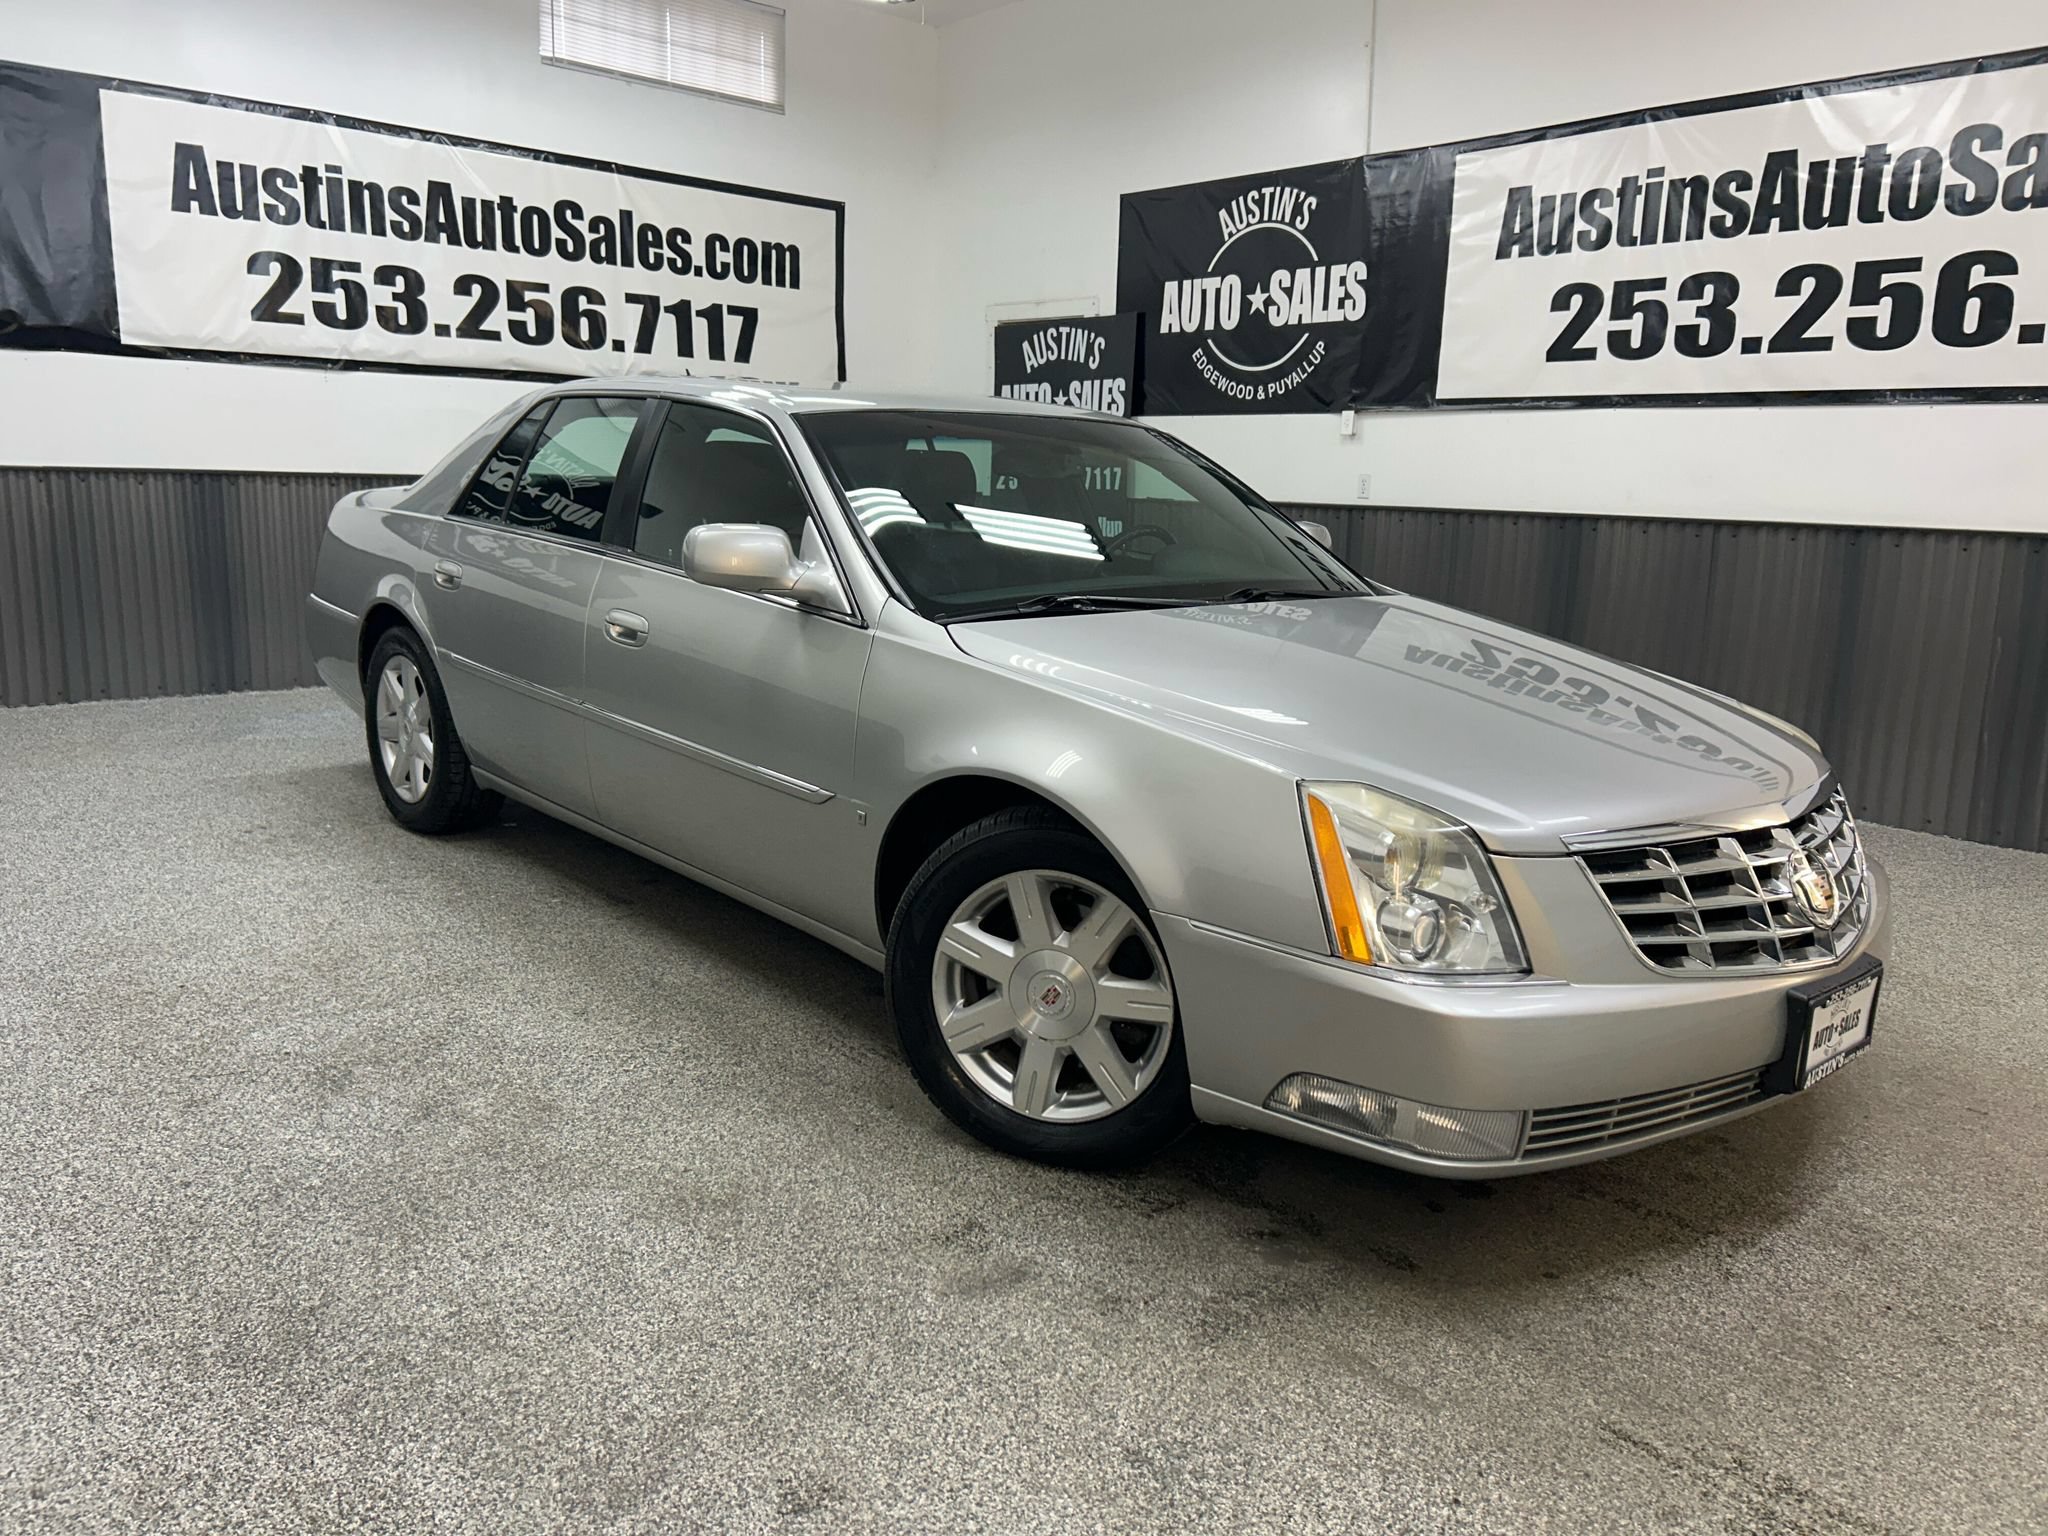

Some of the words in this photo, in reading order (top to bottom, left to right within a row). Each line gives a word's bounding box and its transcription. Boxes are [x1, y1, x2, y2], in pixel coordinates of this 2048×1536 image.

[171, 141, 801, 291] AustinsAutoSales.com
[1218, 186, 1318, 241] AUSTIN'S
[1495, 123, 2048, 260] AustinsAutoSa
[246, 250, 760, 364] 253.256.7117
[1159, 274, 1242, 334] AUTO
[1268, 260, 1368, 327] SALES
[1021, 326, 1106, 374] AUSTIN'S
[1191, 347, 1255, 400] EDGEWOOD
[1256, 385, 1266, 400] &
[1267, 340, 1326, 398] PUYALLUP
